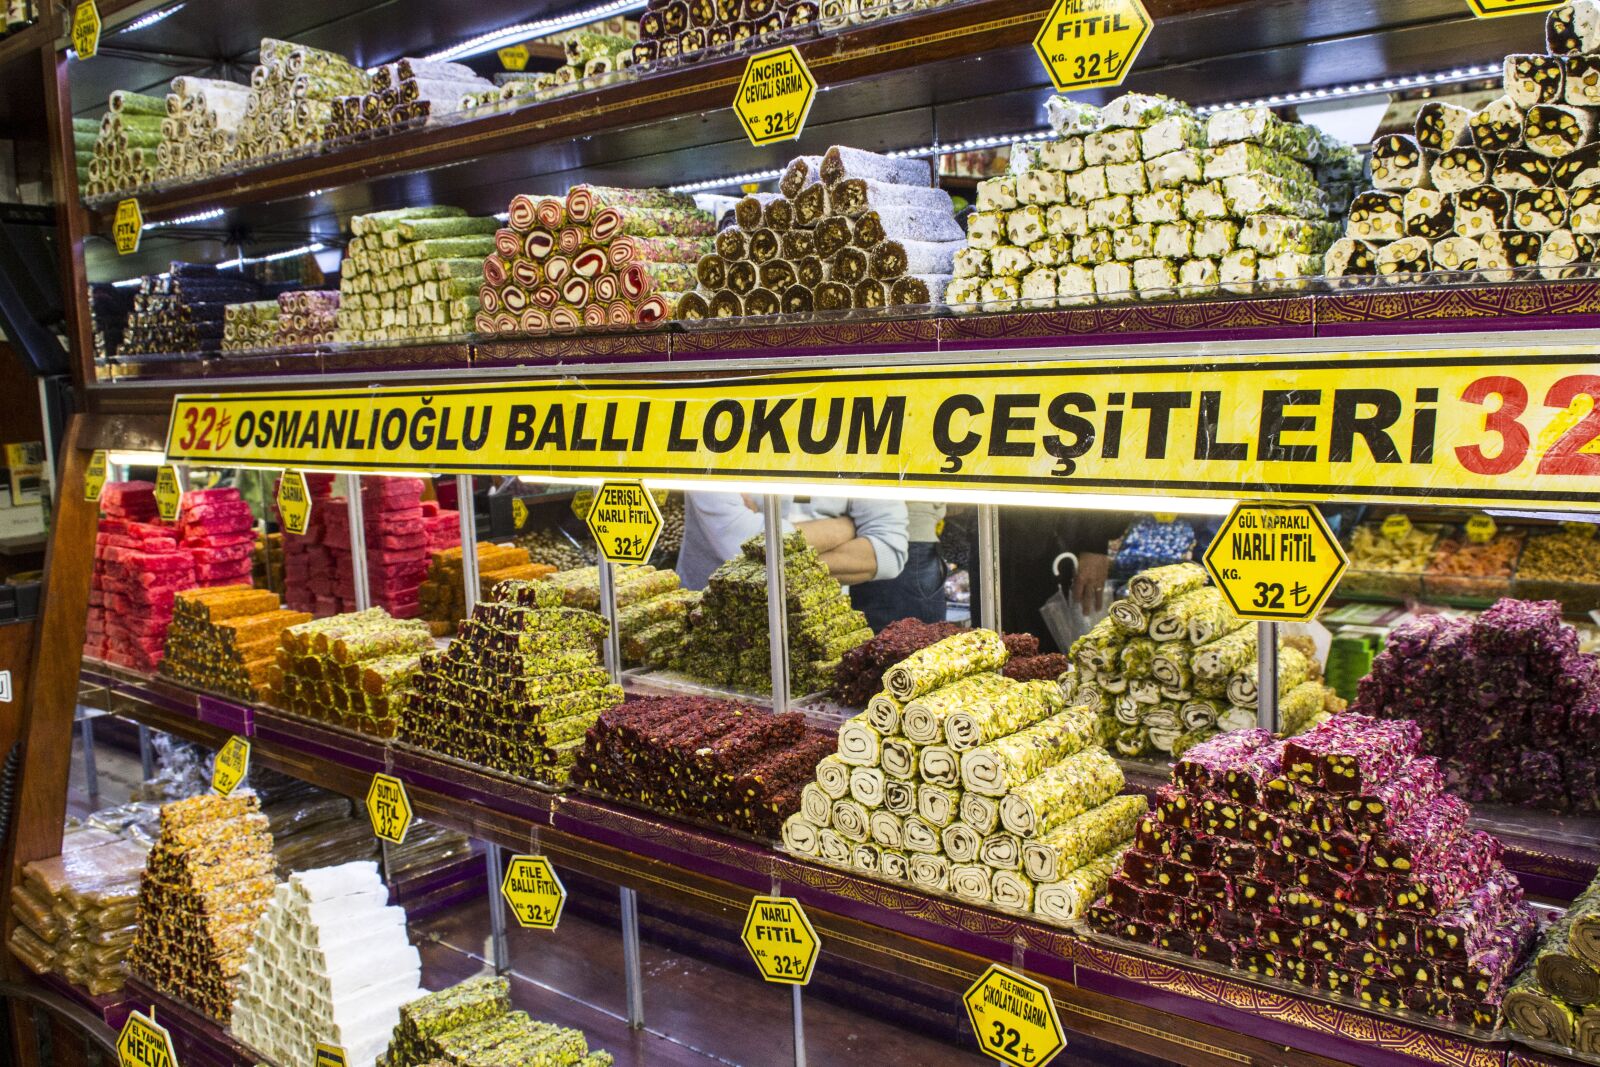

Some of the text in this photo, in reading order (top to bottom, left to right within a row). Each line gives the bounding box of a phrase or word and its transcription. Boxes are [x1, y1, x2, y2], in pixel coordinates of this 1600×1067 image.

[775, 74, 803, 97] SARMA
[234, 396, 492, 451] OSMANLIOĞLU
[505, 401, 651, 452] BALLI
[667, 395, 906, 456] LOKUM
[932, 387, 1439, 477] ÇEŞİTLERİ
[598, 509, 627, 523] NARLI
[1238, 511, 1309, 530] GÜL YAPRAKLI
[1232, 532, 1276, 562] NARLI
[1222, 569, 1242, 580] KG.
[511, 878, 535, 893] BALLI
[761, 906, 791, 923] NARLI
[1023, 1002, 1047, 1030] SARMA
[132, 1025, 140, 1037] EL
